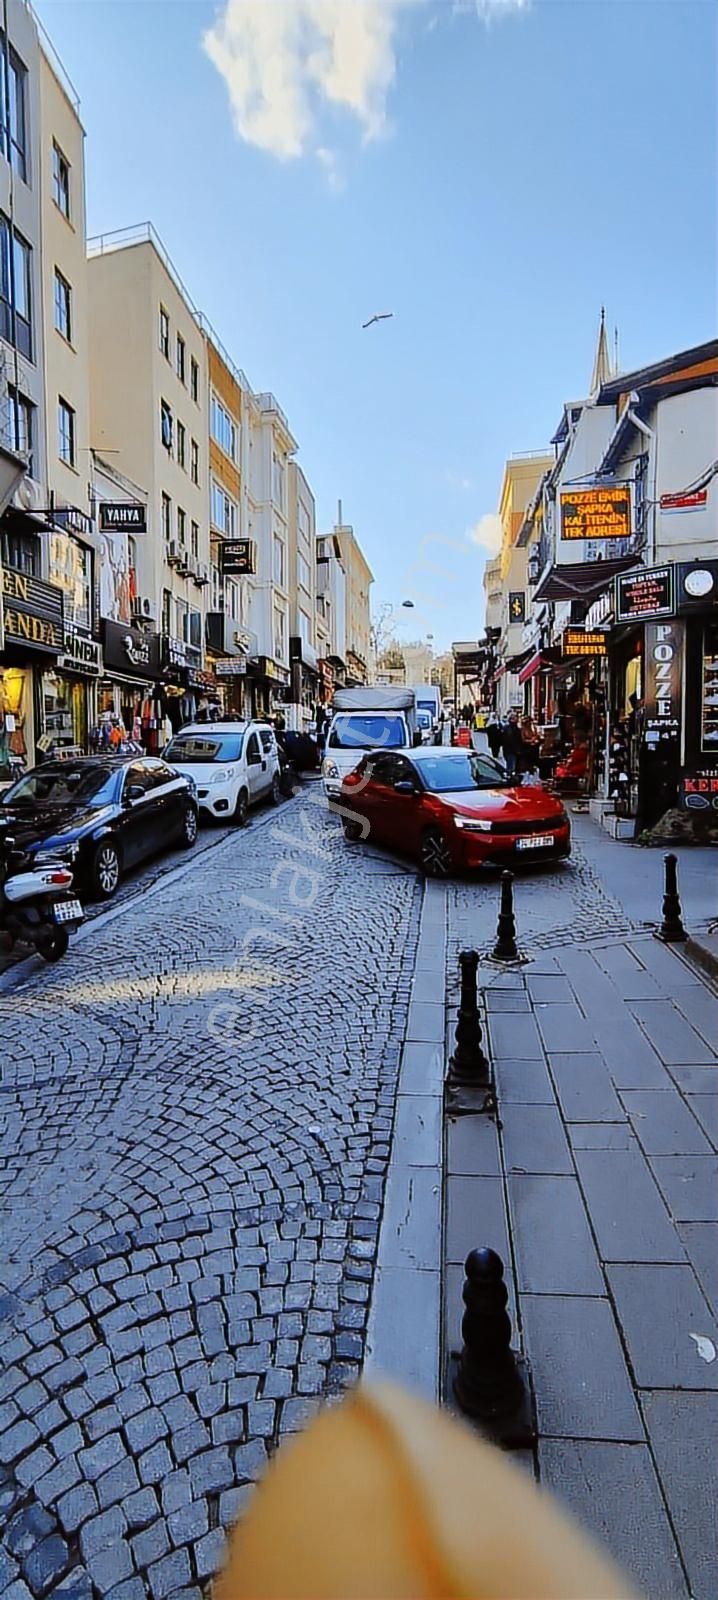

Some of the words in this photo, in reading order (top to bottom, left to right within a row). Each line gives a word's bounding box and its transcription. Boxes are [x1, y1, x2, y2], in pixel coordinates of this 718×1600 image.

[561, 493, 597, 505] POZZE
[598, 490, 628, 503] EMİR
[107, 508, 139, 521] YAHYA
[576, 503, 613, 515] ŞAPKA
[564, 512, 627, 527] KALİTENİN
[564, 527, 585, 538] TEK
[585, 523, 628, 537] ADRESİ
[653, 624, 674, 716] POZZE
